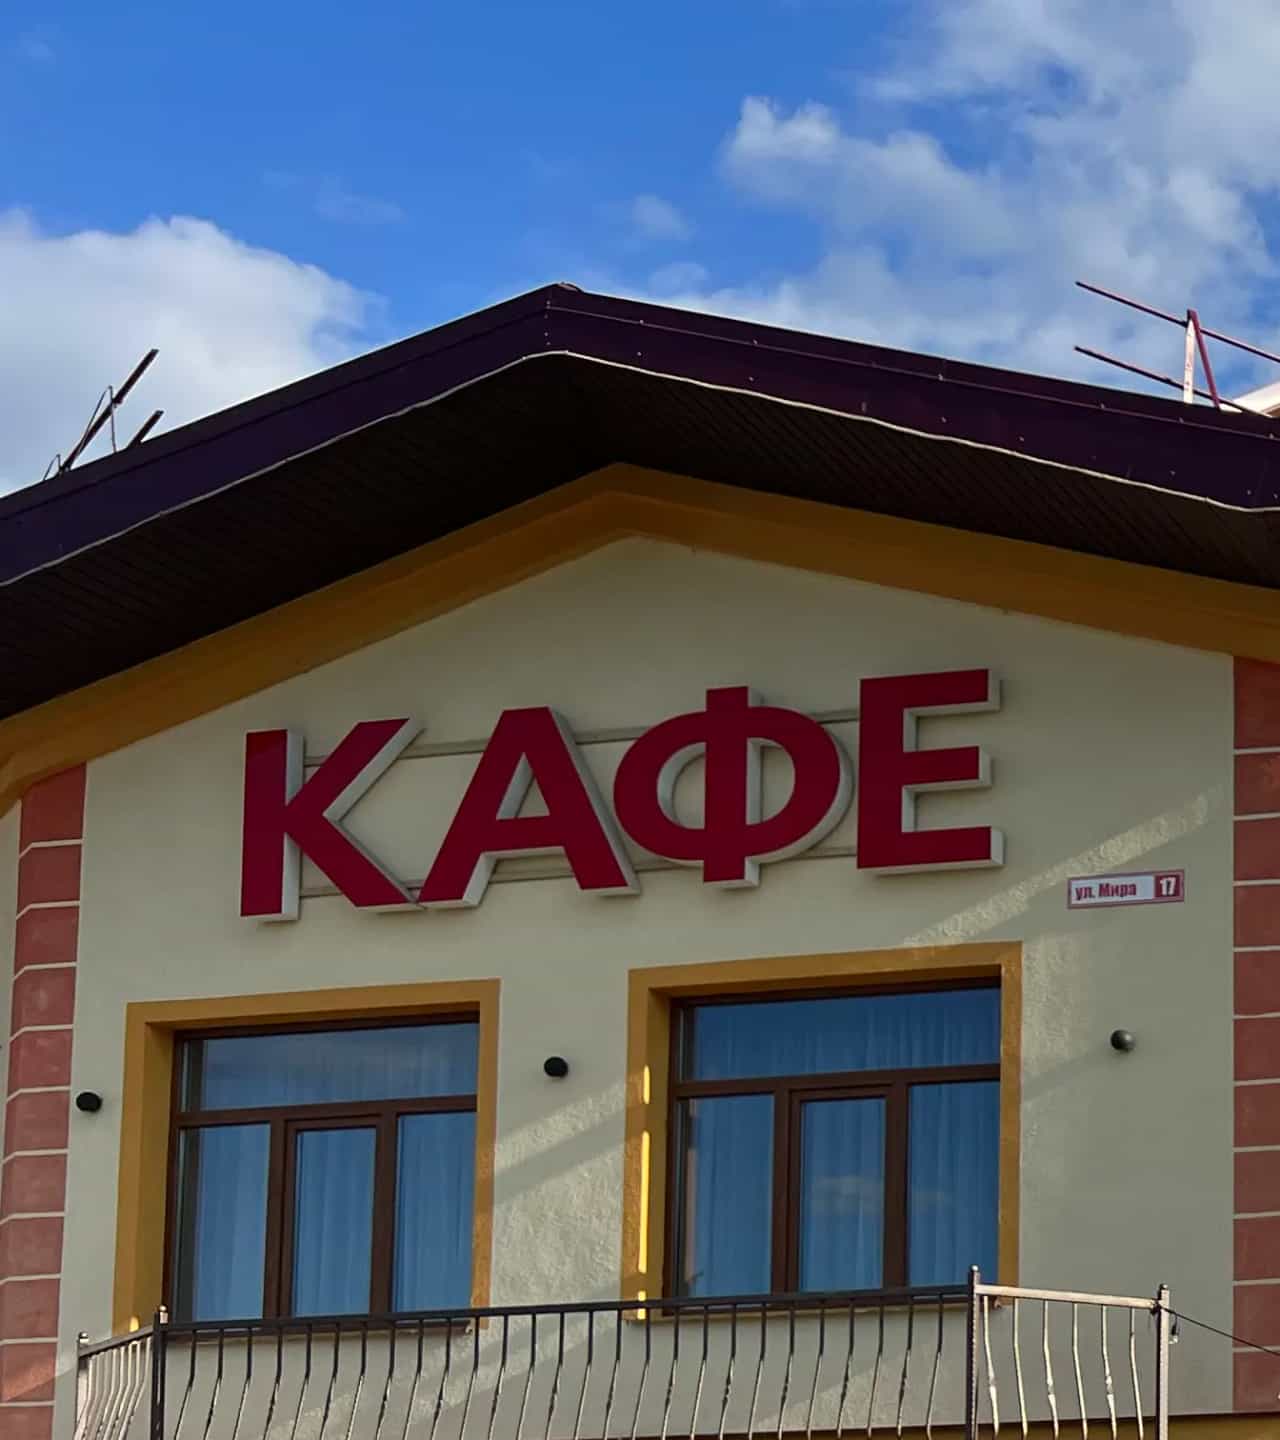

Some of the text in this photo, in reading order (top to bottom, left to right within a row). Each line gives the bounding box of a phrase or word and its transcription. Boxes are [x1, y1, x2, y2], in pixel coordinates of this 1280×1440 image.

[241, 668, 1003, 919] КАФЕ
[1075, 877, 1176, 901] ул. Мира 17
